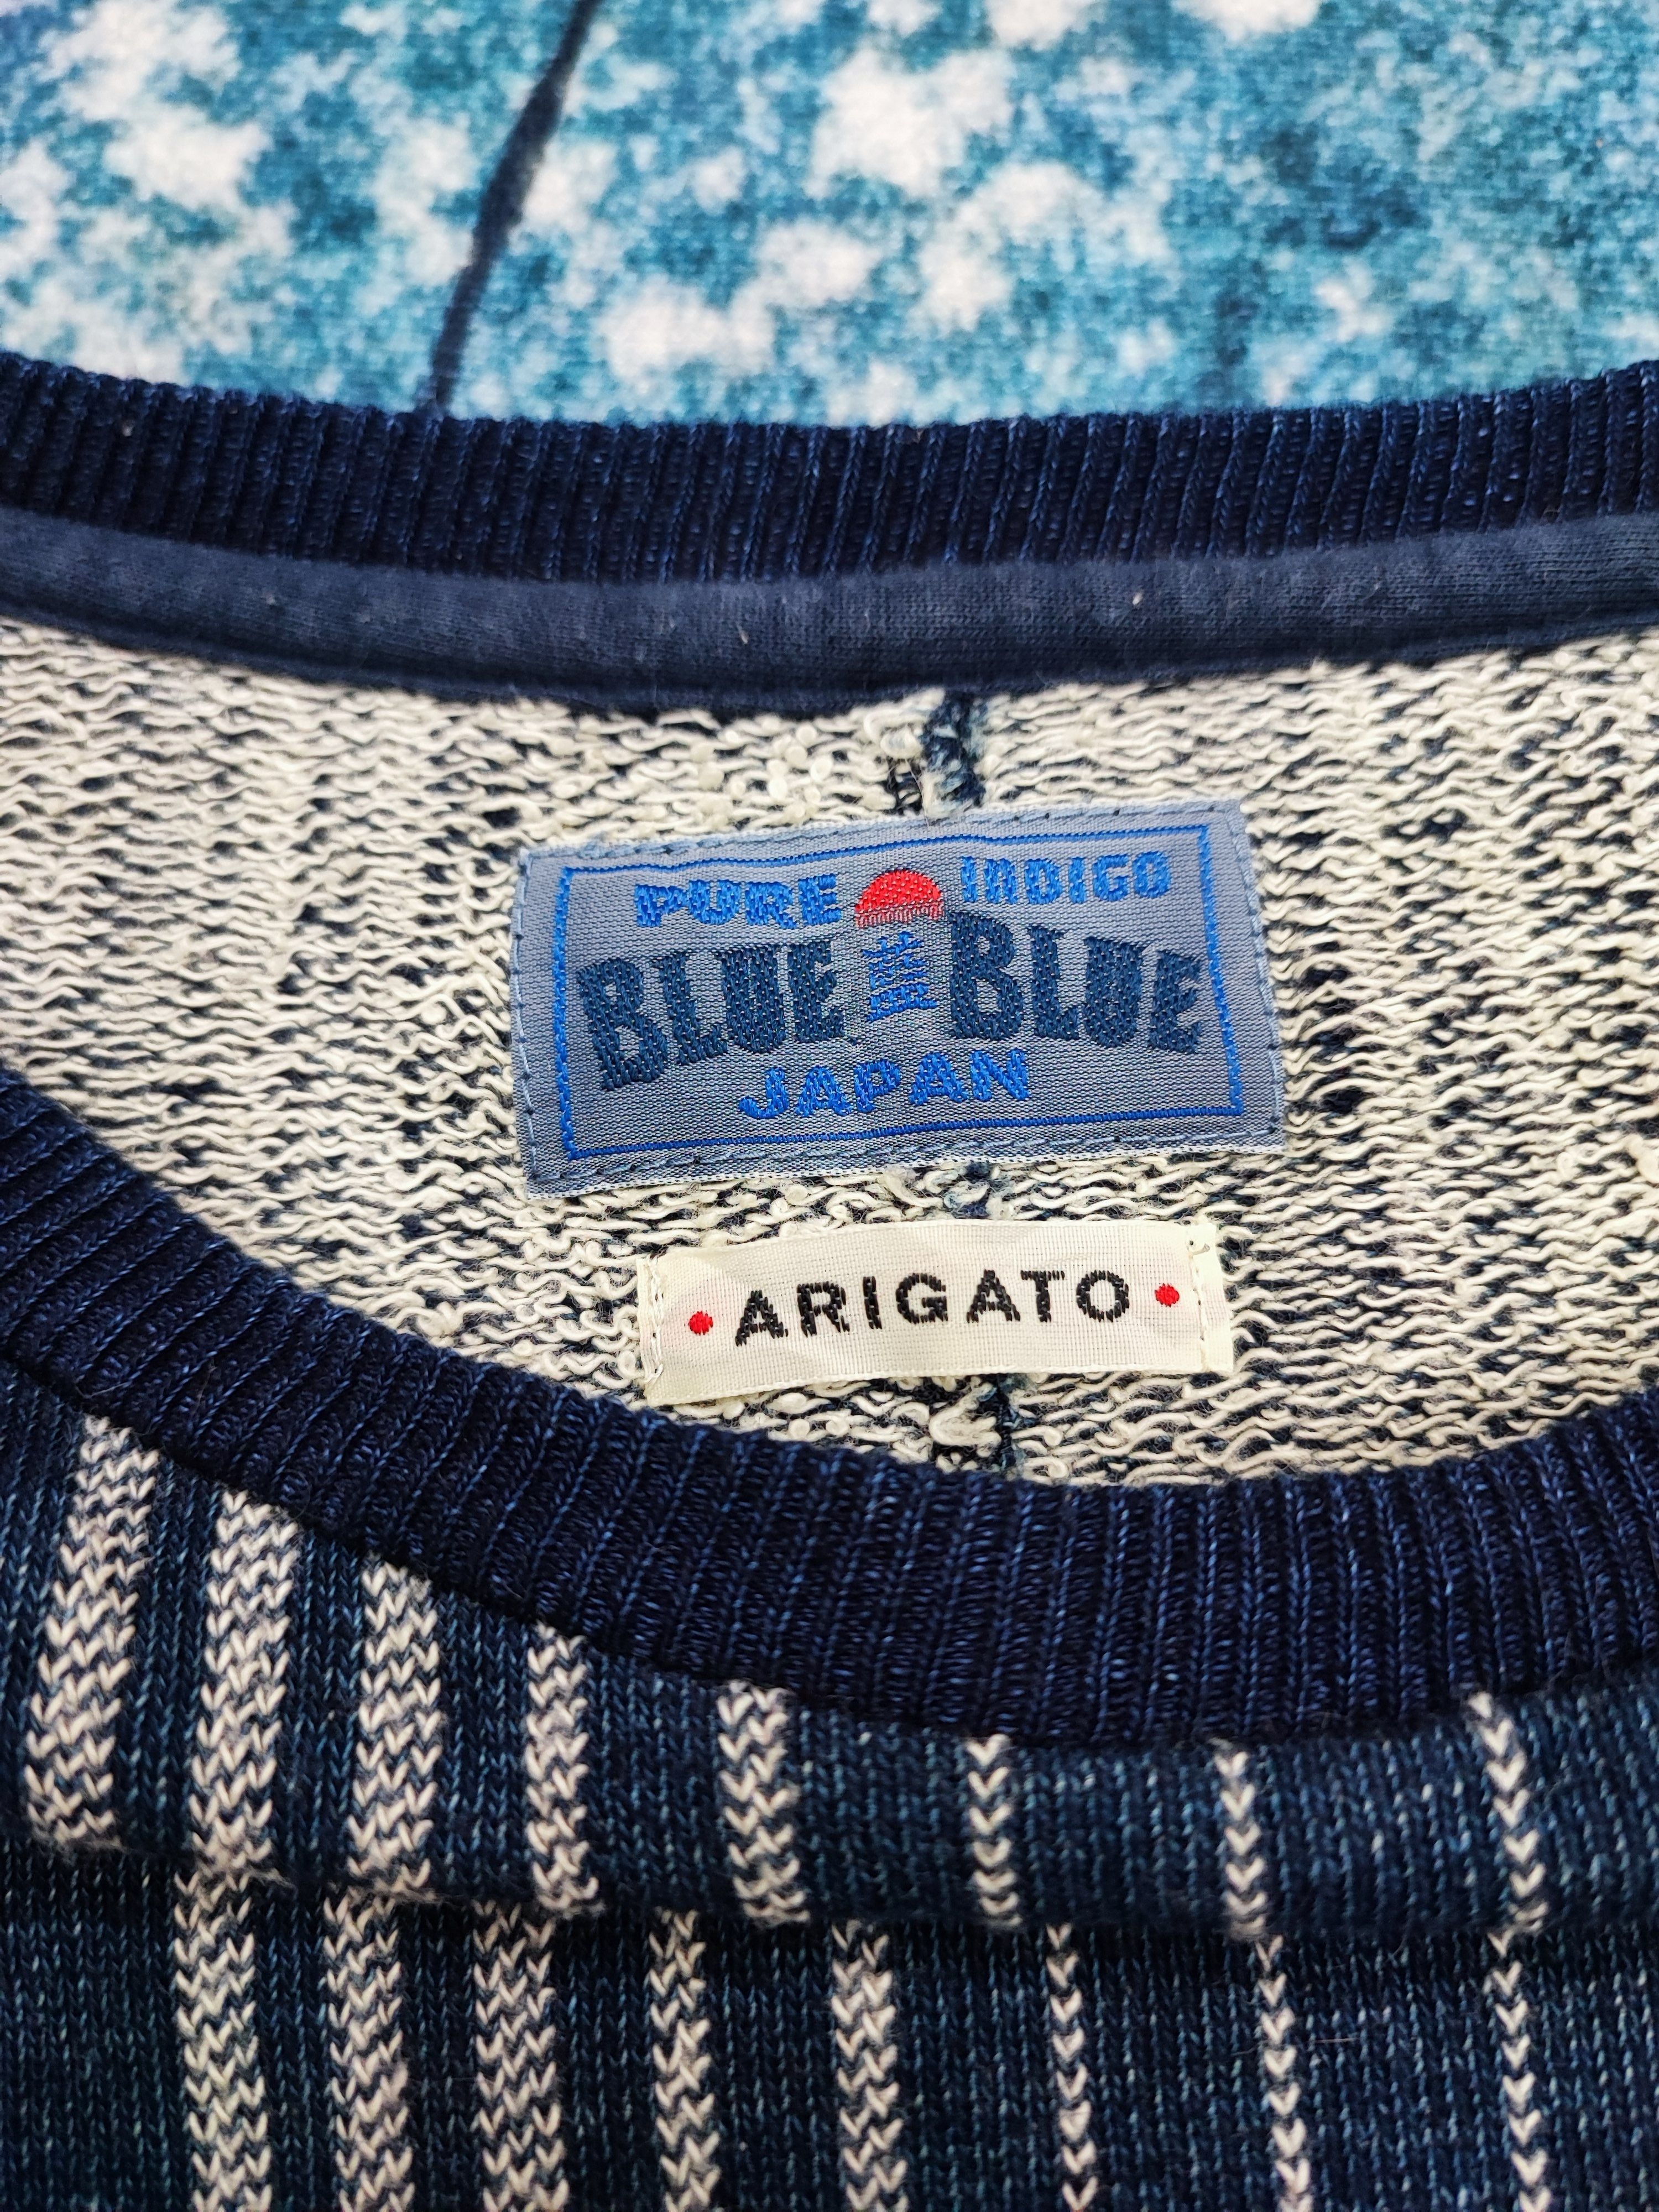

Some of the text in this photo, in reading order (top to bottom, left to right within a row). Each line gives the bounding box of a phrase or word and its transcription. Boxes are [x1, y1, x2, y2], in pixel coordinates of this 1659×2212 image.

[634, 851, 1170, 929] PURE INDIGO
[575, 936, 845, 1091] BLUE
[947, 911, 1203, 1055] BLUE
[739, 1048, 1031, 1119] JAPAN
[735, 1268, 1130, 1347] ARIGATO
